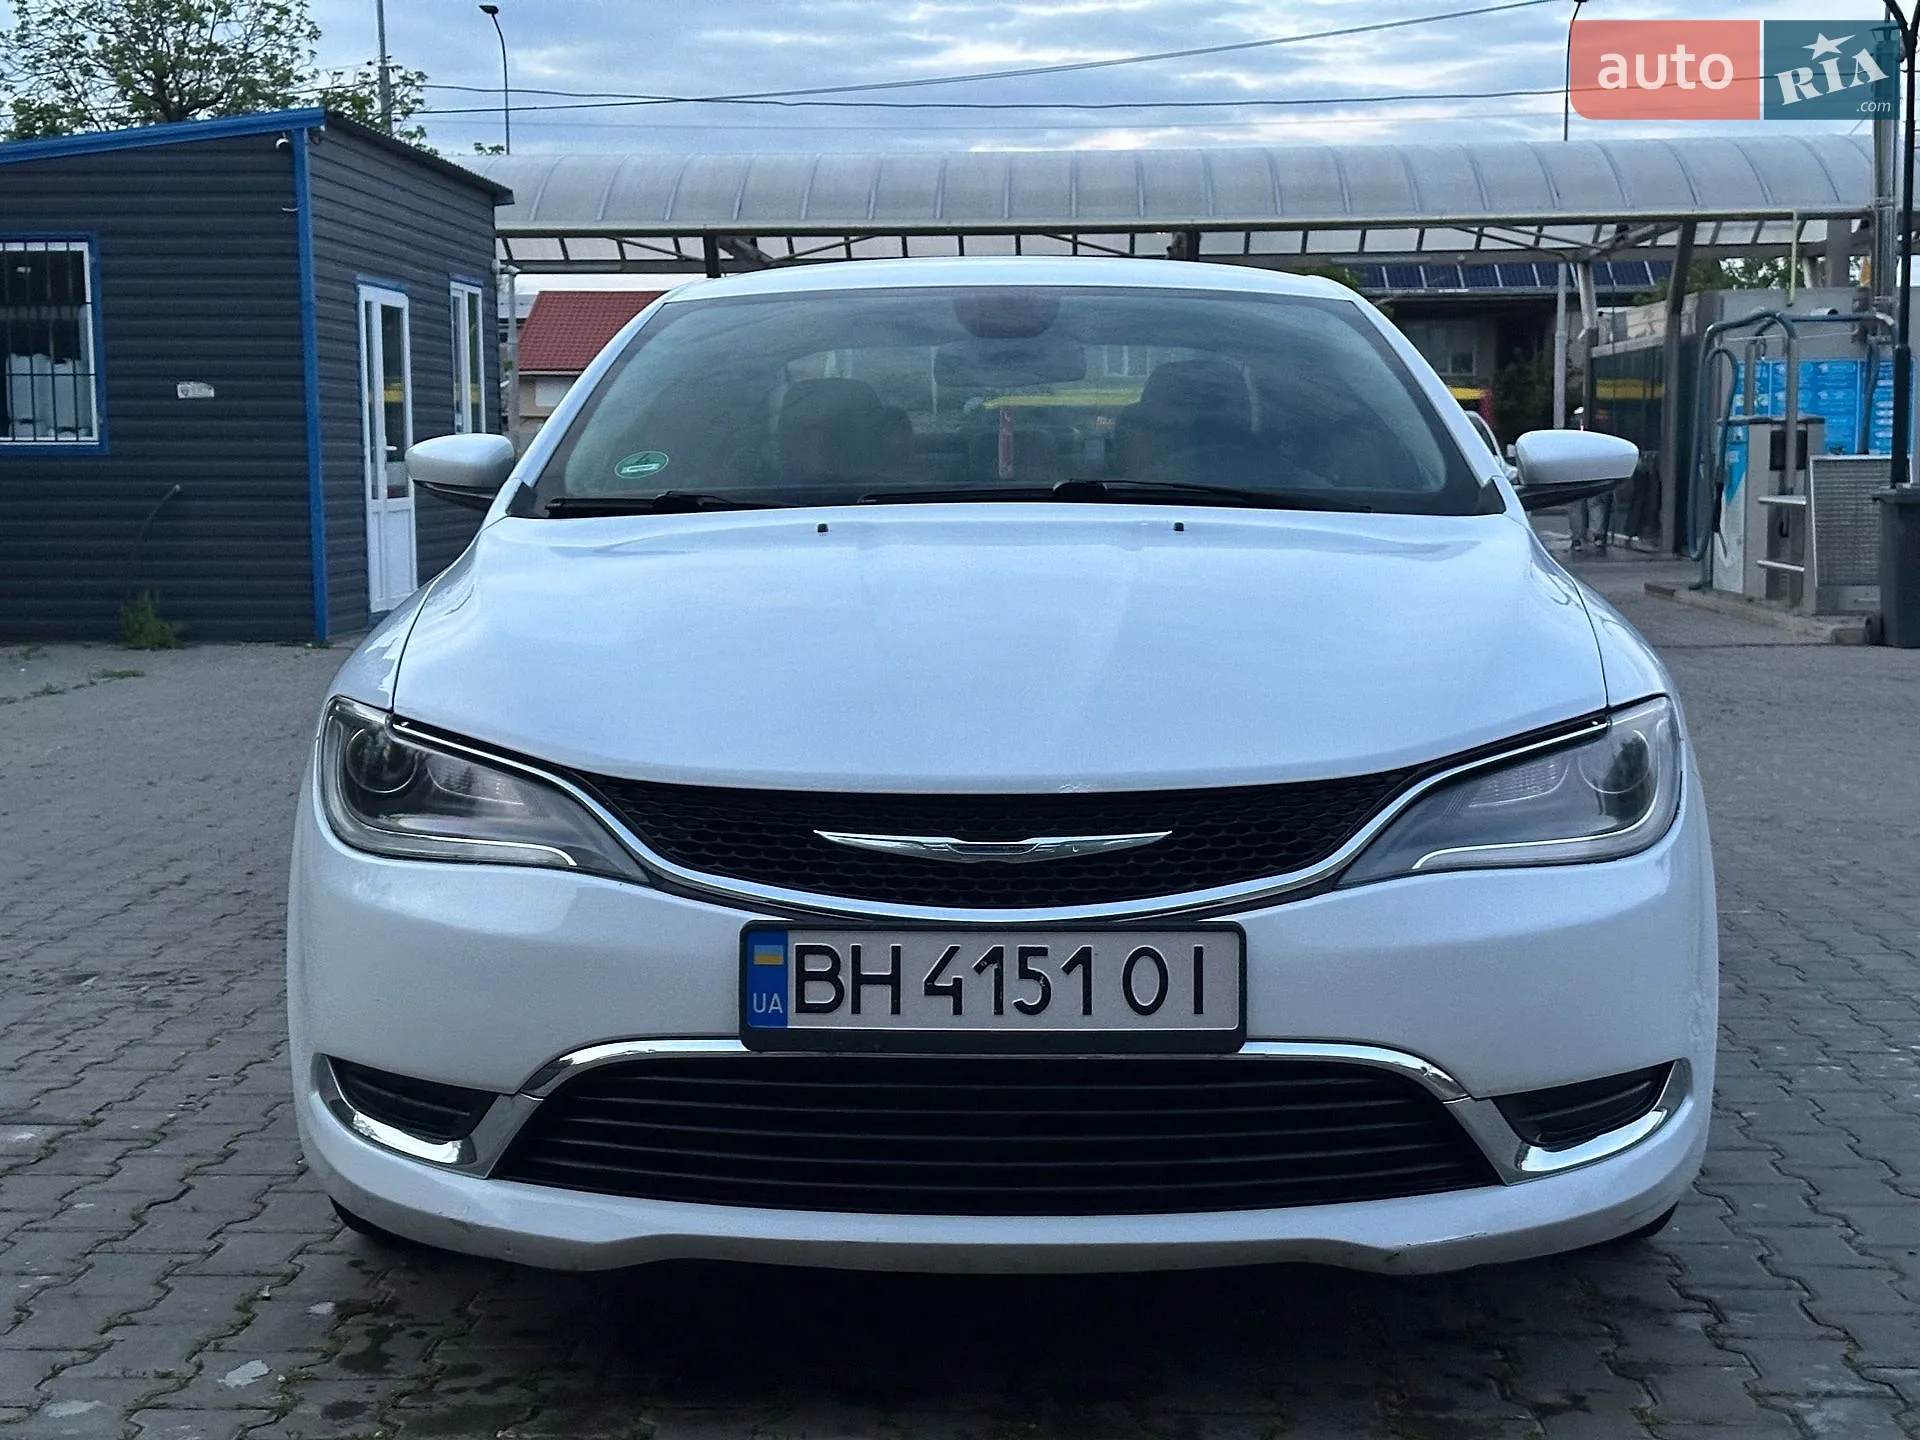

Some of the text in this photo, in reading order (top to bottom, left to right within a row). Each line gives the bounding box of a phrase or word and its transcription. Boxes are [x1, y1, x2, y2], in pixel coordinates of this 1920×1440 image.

[752, 992, 784, 1015] UA
[794, 943, 1205, 1017] BH 4151 OI
